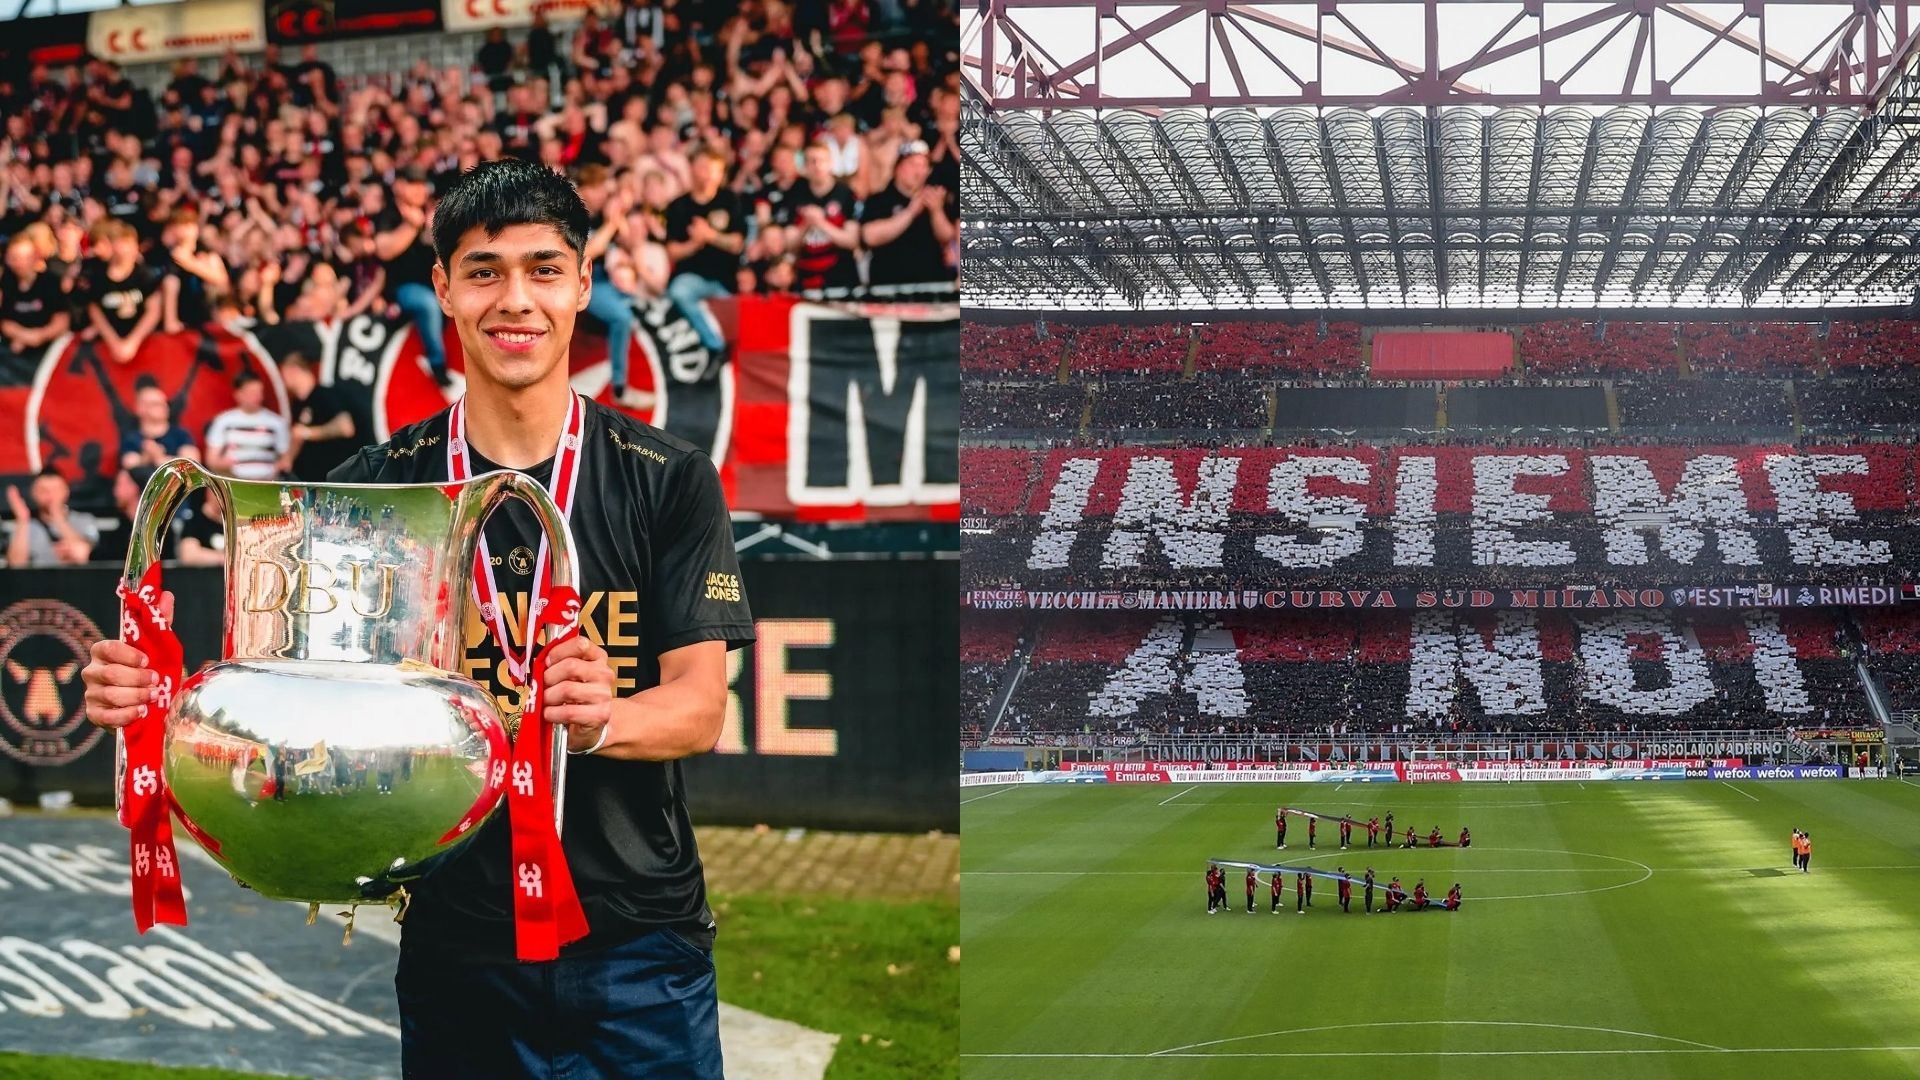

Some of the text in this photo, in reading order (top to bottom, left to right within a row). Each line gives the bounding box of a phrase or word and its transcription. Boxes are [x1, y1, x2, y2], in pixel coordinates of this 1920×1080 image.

[1026, 453, 1890, 570] INSIEME
[247, 559, 403, 618] DBU
[704, 585, 741, 602] JONES
[1027, 591, 1119, 610] VECCHIA
[1138, 591, 1237, 610] MANIERA
[1264, 588, 1665, 608] CURVA SUD MILANO
[1071, 763, 1111, 771] Emirates
[1153, 763, 1193, 771] Emirates
[1236, 763, 1276, 771] Emrates
[1652, 760, 1692, 768] Emirates
[1115, 772, 1160, 782] Emirates
[1176, 772, 1301, 781] YOU WILL ALWAYS FLY BETTER WITH EMIRATES
[1406, 771, 1451, 781] Emirates
[1526, 770, 1547, 779] BETTER
[1548, 770, 1563, 779] WITH
[1564, 770, 1592, 779] EMIRATES
[1686, 769, 1708, 777] 00:00
[1714, 766, 1838, 778] wefox wefox wefox
